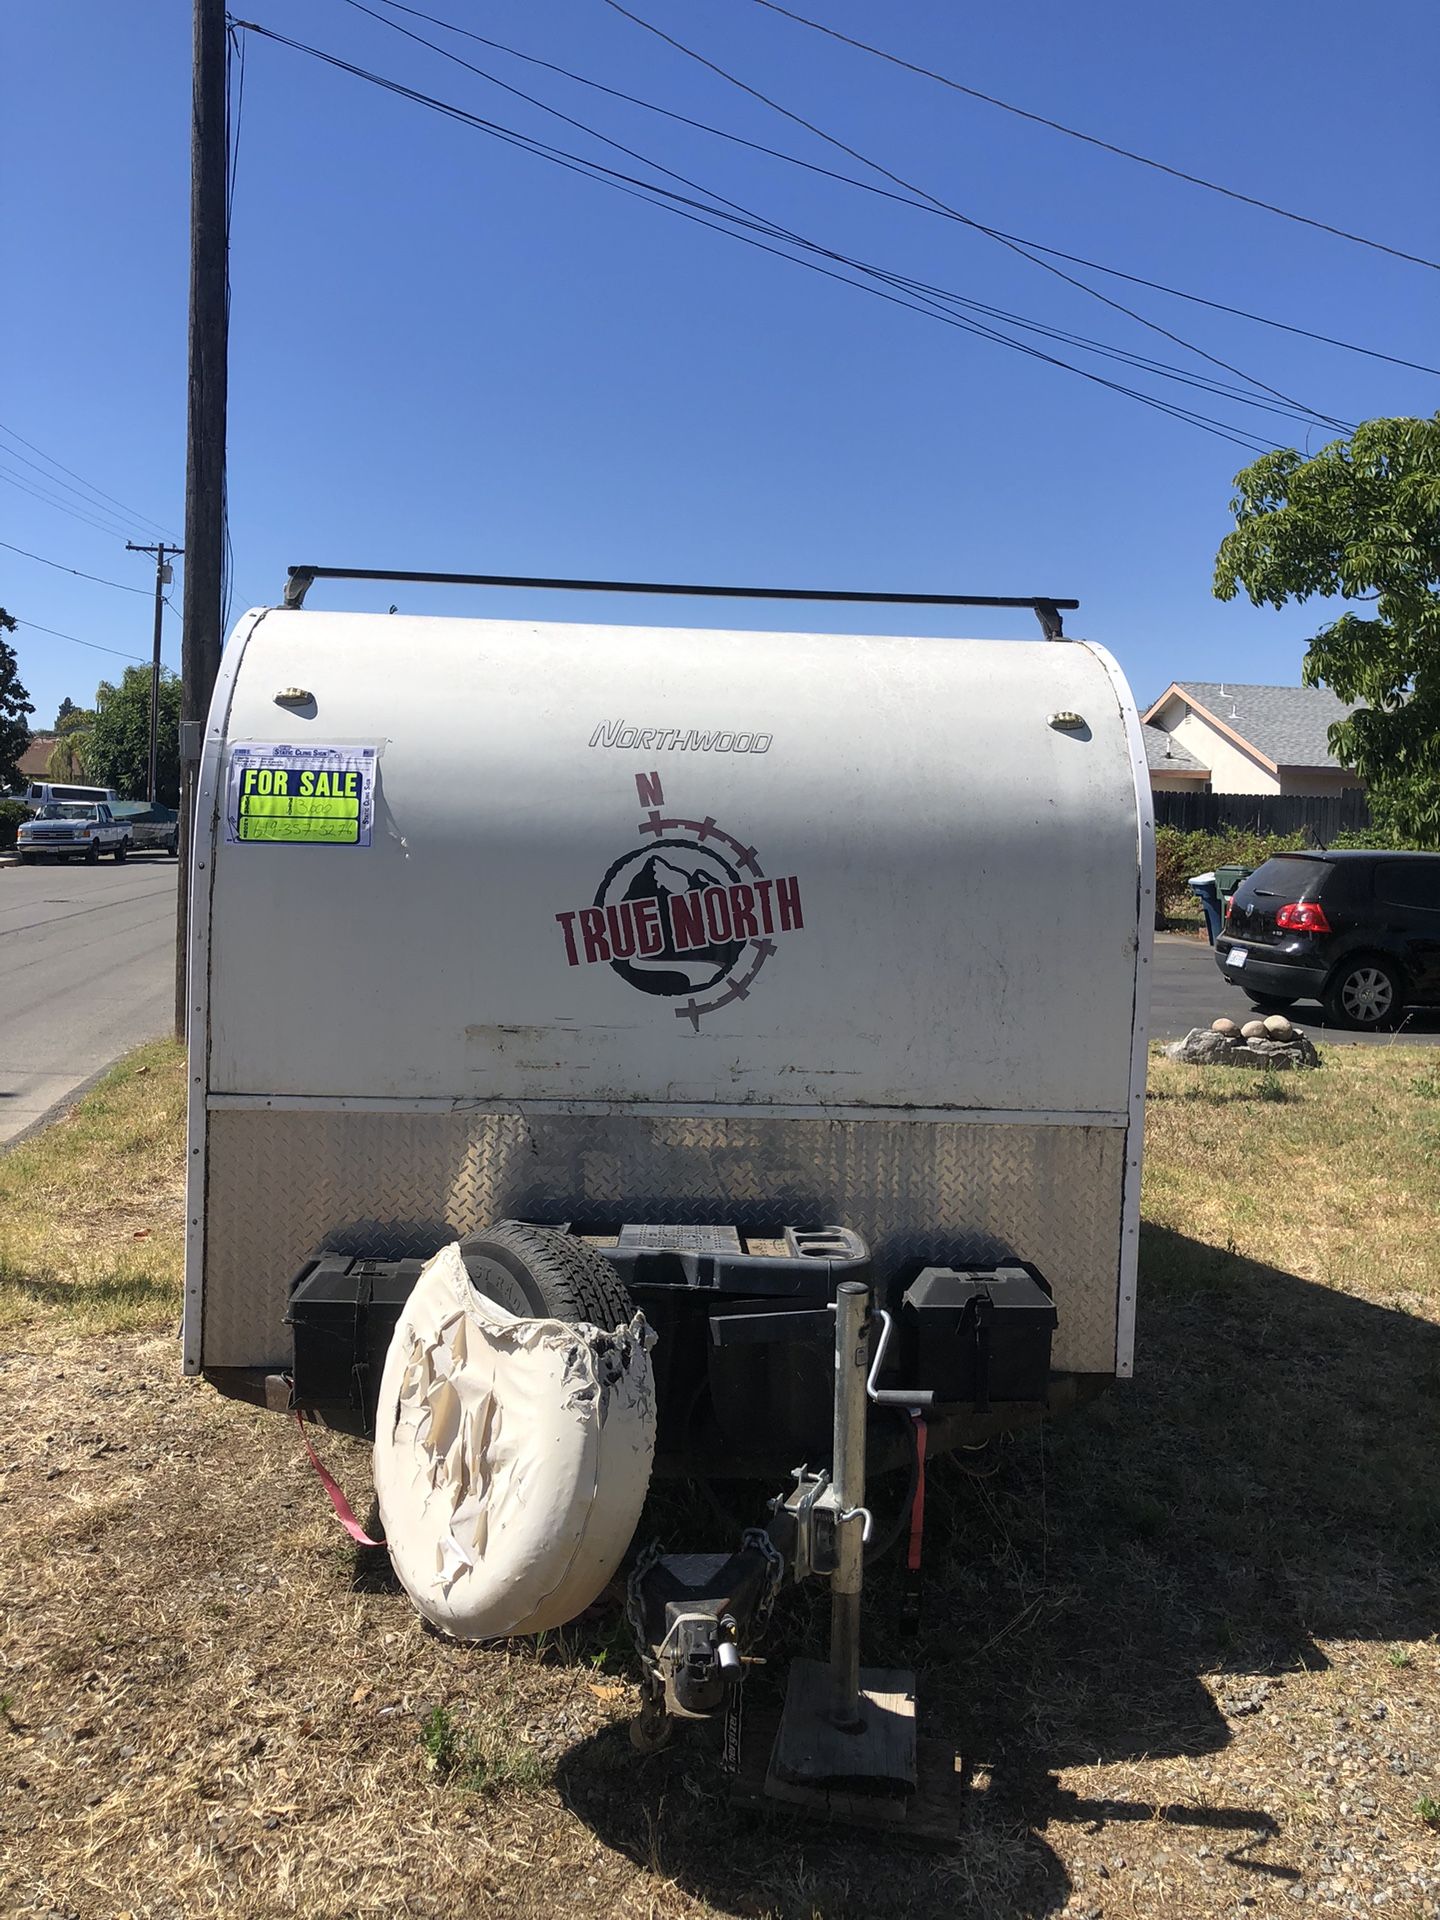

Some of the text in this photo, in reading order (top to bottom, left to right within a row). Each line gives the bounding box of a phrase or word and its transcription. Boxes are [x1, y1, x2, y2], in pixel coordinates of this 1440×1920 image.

[588, 718, 774, 754] NORTHWOOD
[244, 770, 357, 797] FOR SALE
[635, 771, 665, 807] N
[555, 875, 804, 966] TRUE NORTH
